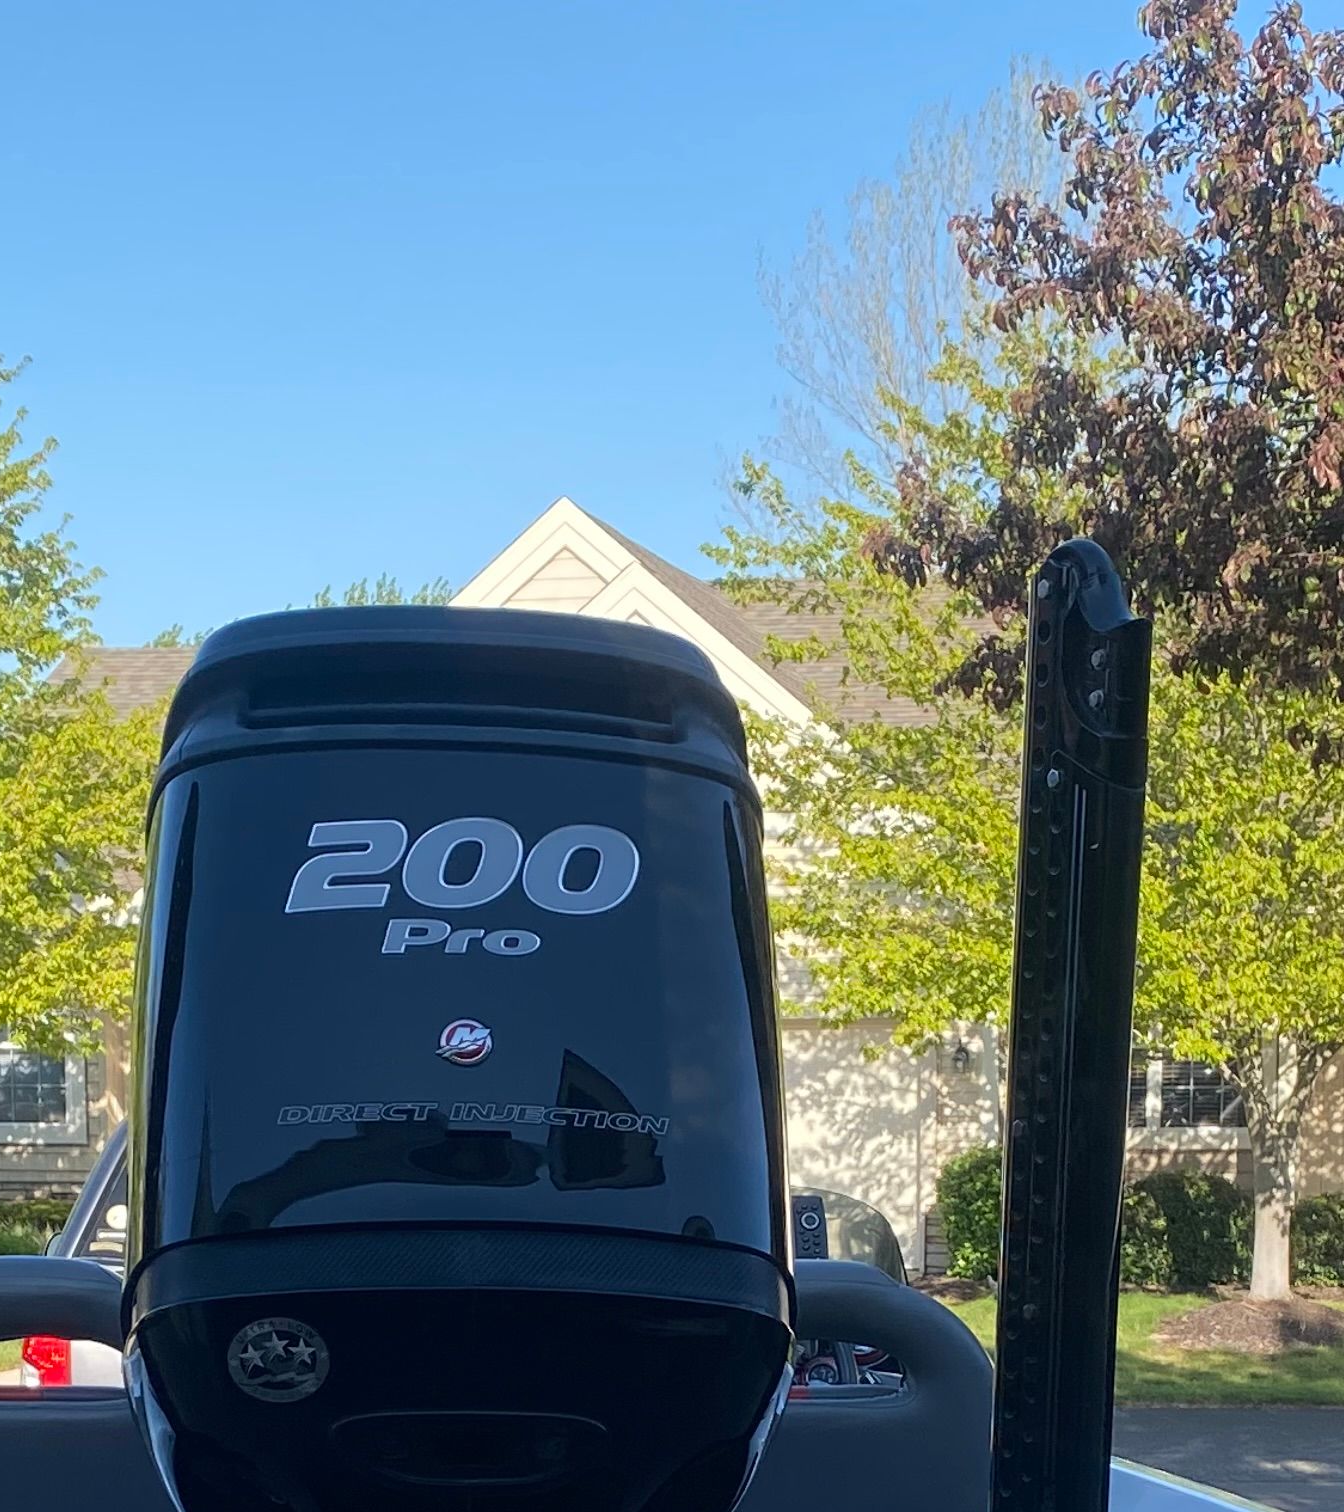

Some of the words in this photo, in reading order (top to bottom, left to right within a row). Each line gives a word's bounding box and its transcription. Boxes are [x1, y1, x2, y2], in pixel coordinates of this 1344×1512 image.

[285, 817, 640, 914] 200
[381, 918, 541, 956] Pro
[276, 1102, 438, 1125] DIRECT
[447, 1102, 670, 1135] INJECTION
